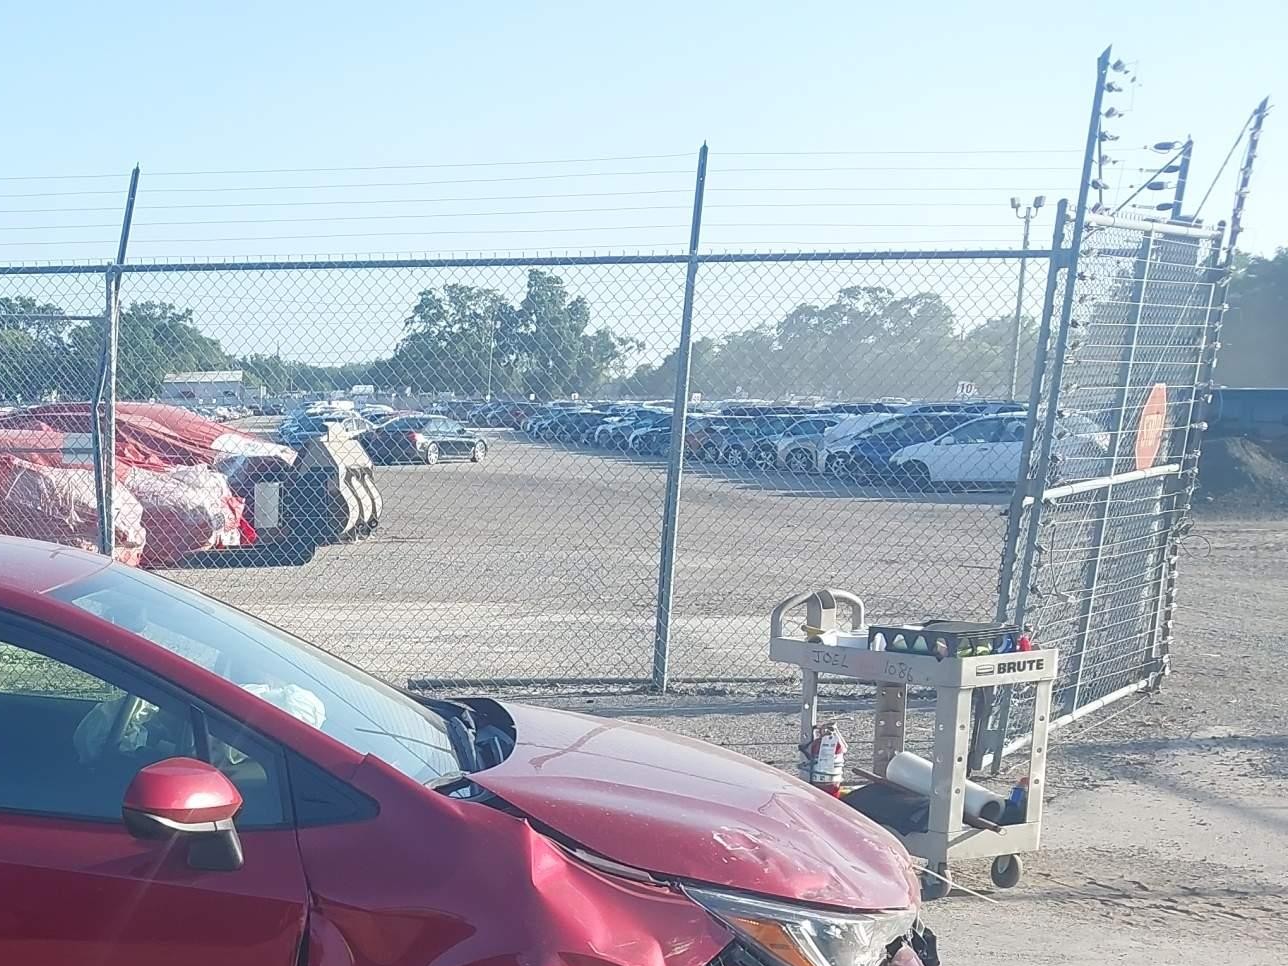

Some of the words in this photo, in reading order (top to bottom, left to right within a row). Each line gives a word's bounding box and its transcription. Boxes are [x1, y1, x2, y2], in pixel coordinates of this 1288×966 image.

[812, 649, 849, 669] JOEL
[884, 660, 913, 682] 1086
[997, 658, 1044, 675] BRUTE
